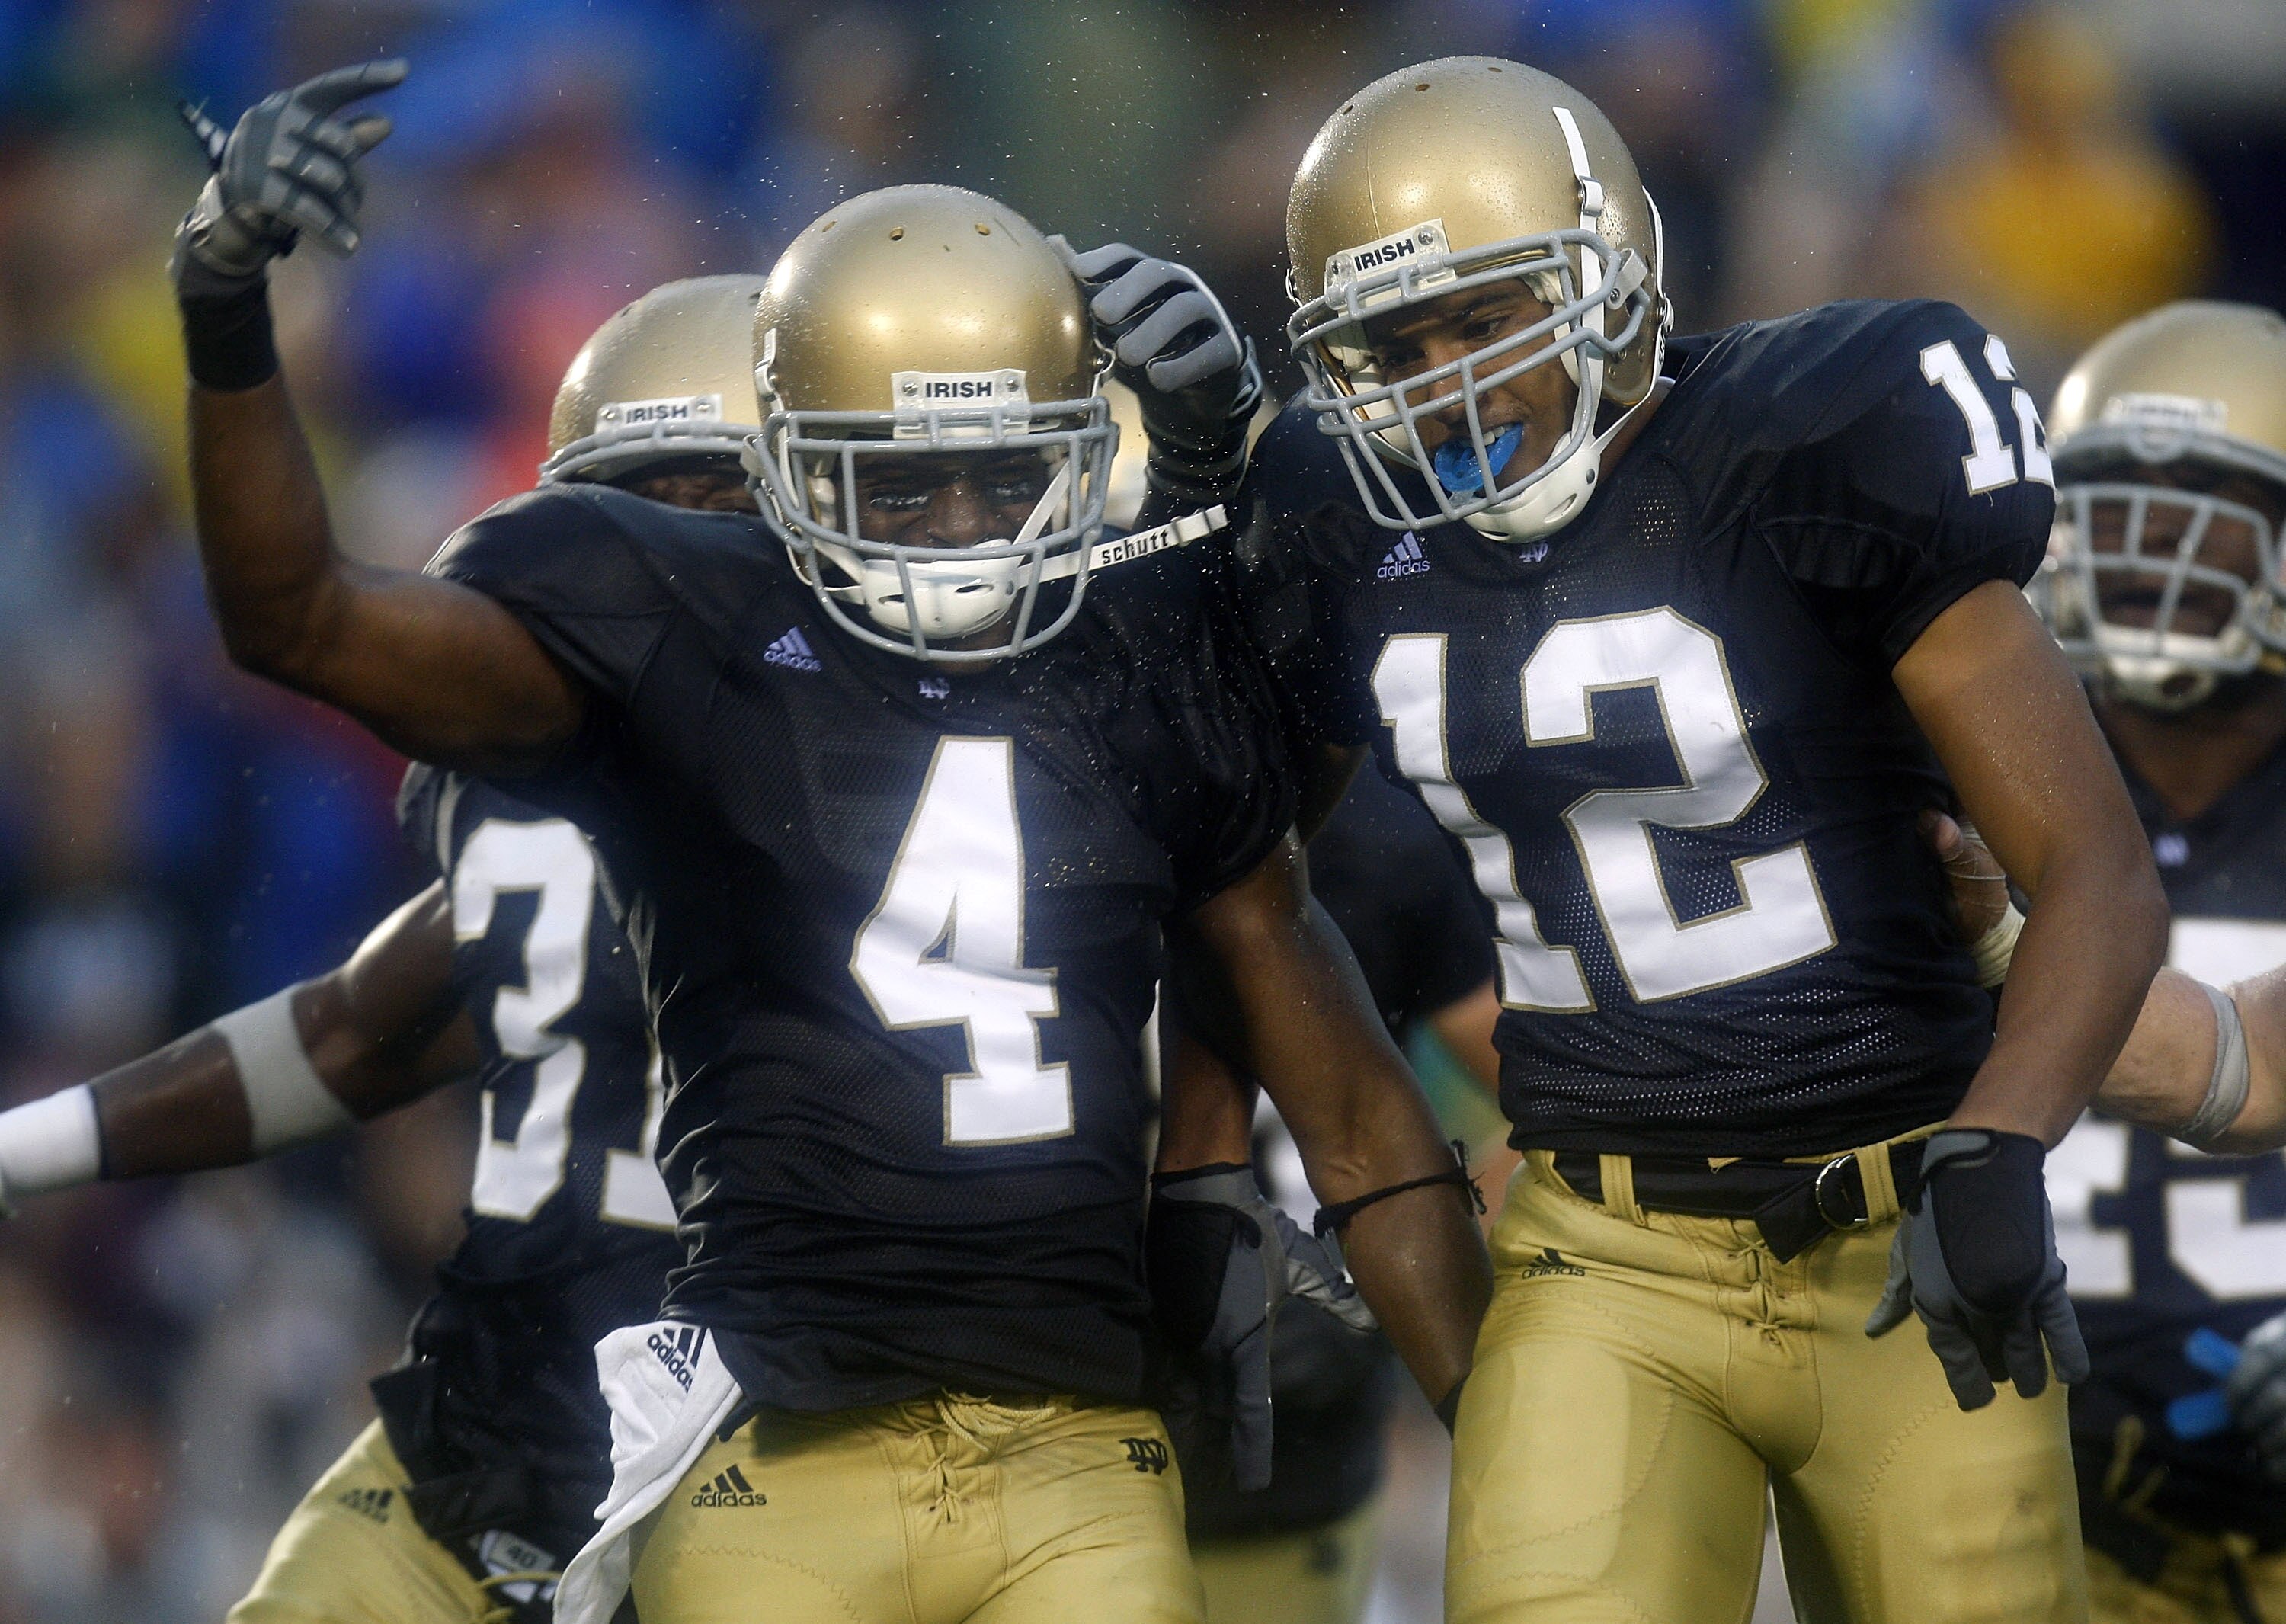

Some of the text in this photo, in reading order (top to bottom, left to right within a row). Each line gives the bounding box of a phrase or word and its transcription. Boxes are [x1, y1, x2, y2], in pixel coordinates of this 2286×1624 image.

[1354, 238, 1415, 271] IRISH
[926, 381, 991, 399] IRISH
[626, 404, 688, 424] IRISH
[1102, 530, 1168, 565] schutt
[1377, 559, 1430, 579] adidas
[1372, 605, 1838, 1014] 12
[848, 735, 1074, 1146] 4
[691, 1491, 767, 1507] adidas
